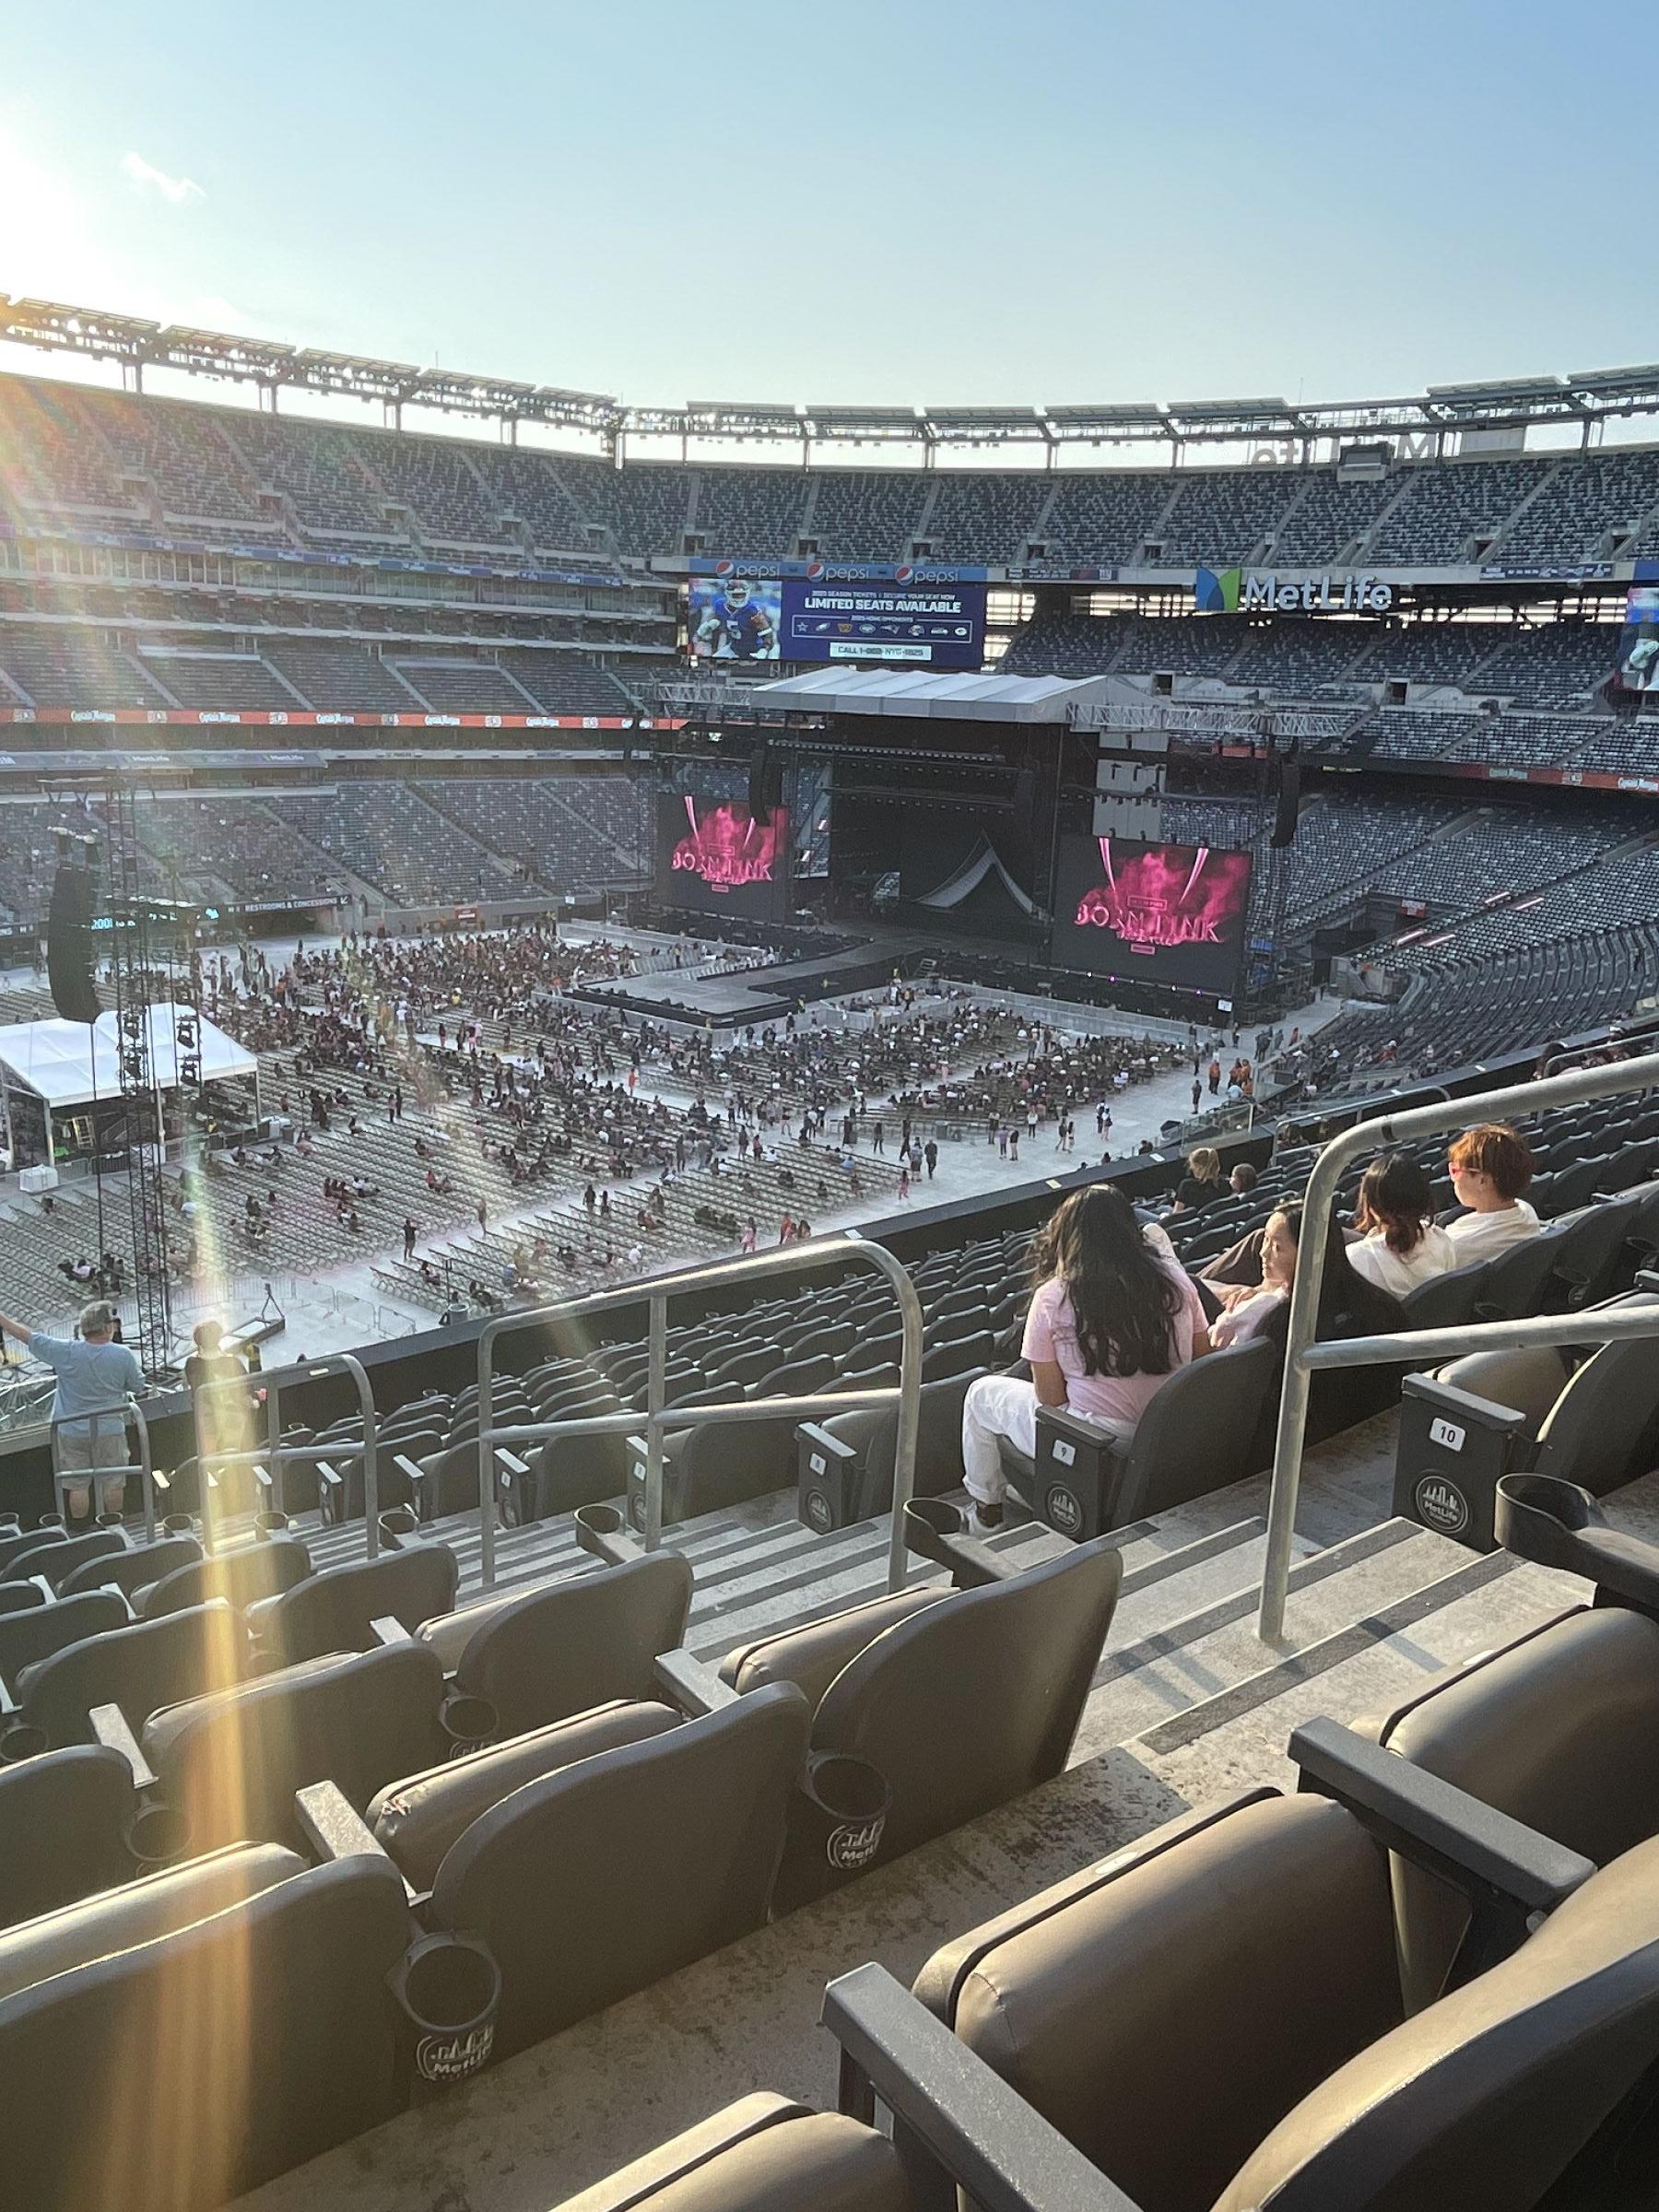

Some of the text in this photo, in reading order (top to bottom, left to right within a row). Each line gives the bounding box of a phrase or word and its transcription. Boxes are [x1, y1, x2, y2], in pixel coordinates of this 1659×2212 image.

[736, 565, 780, 578] pepsi
[825, 567, 870, 582] pepsi
[913, 569, 959, 584] pepsi
[1245, 575, 1393, 611] MetLife
[804, 597, 962, 614] LIMITED SEATS AVAILABLE
[838, 646, 857, 654] CALL
[244, 901, 286, 912] RESTROOMS
[293, 897, 337, 909] CONCESSIONS
[1441, 1426, 1455, 1442] 10
